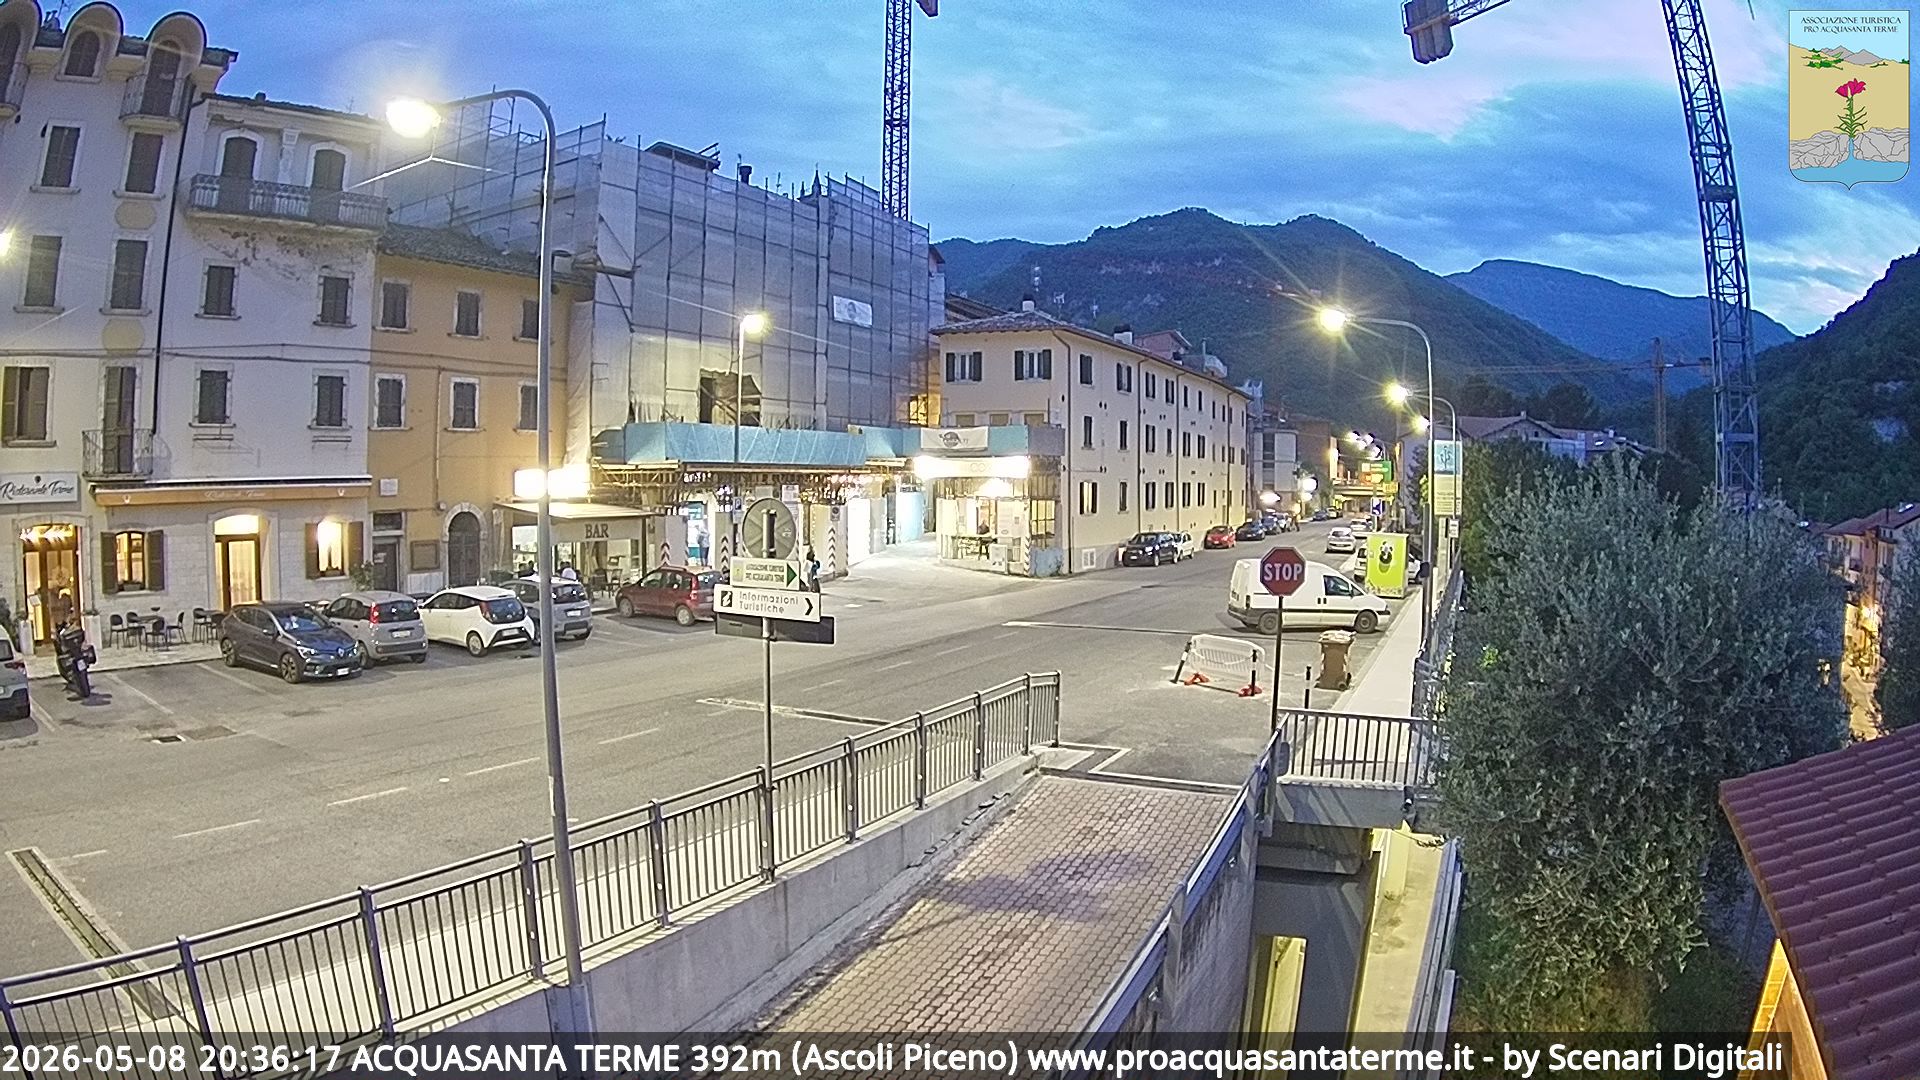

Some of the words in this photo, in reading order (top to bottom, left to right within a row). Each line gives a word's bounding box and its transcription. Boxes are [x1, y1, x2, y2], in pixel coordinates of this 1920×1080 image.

[585, 523, 609, 539] BAR
[1263, 562, 1303, 581] STOP
[739, 591, 799, 606] Informazioni
[739, 601, 785, 614] Turistiche
